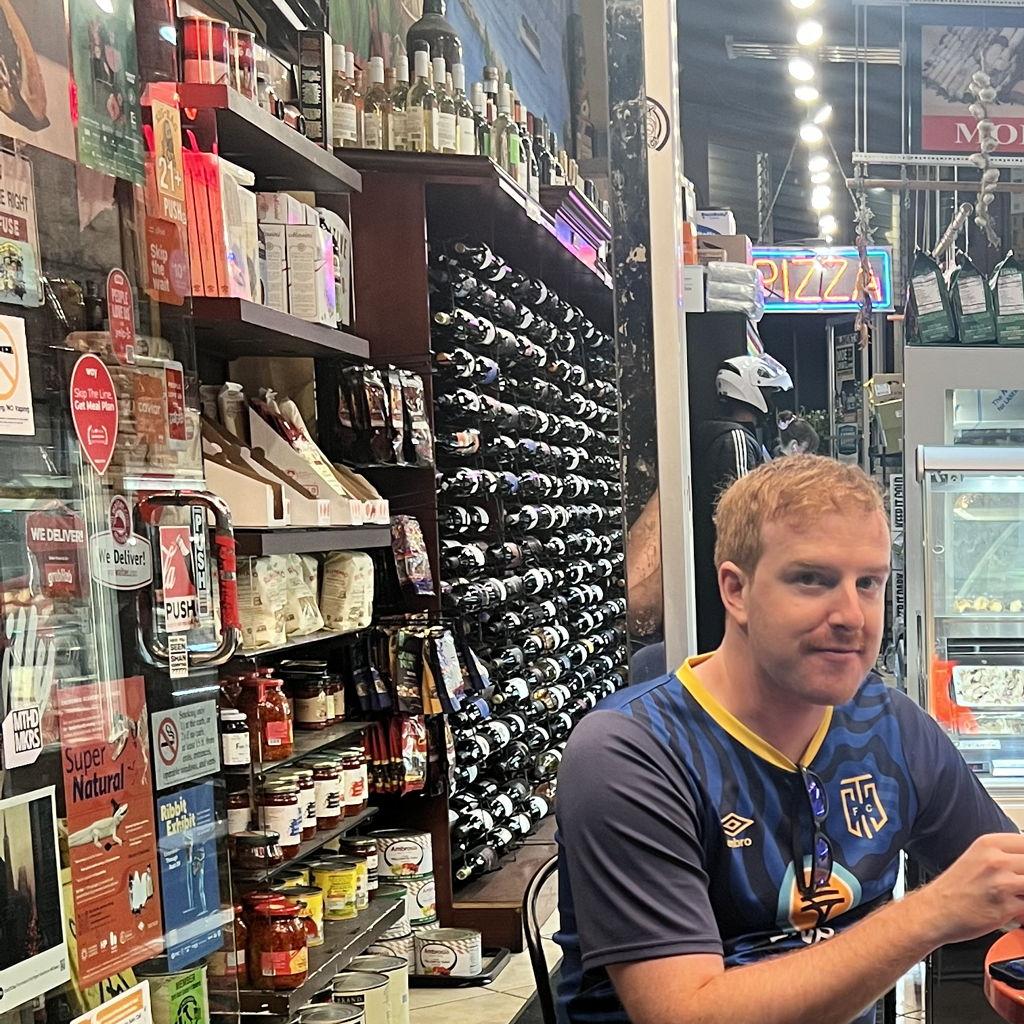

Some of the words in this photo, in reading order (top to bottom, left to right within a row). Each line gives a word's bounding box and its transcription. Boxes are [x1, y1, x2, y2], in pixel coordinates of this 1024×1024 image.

[753, 258, 882, 303] PIZZA
[74, 387, 87, 400] Skip
[88, 388, 99, 399] The
[74, 400, 85, 410] Get
[86, 400, 101, 411] Meal
[101, 401, 115, 412] Plan
[30, 527, 45, 541] WE
[47, 528, 84, 543] DELIVER!
[99, 549, 111, 564] We
[114, 549, 146, 566] Deliver!
[166, 601, 197, 620] PUSH
[13, 708, 39, 732] MTHD
[14, 728, 41, 753] MKRS
[65, 746, 106, 776] Super
[72, 764, 124, 803] Natural
[160, 797, 187, 821] Ribbit
[166, 814, 197, 837] Exhibit
